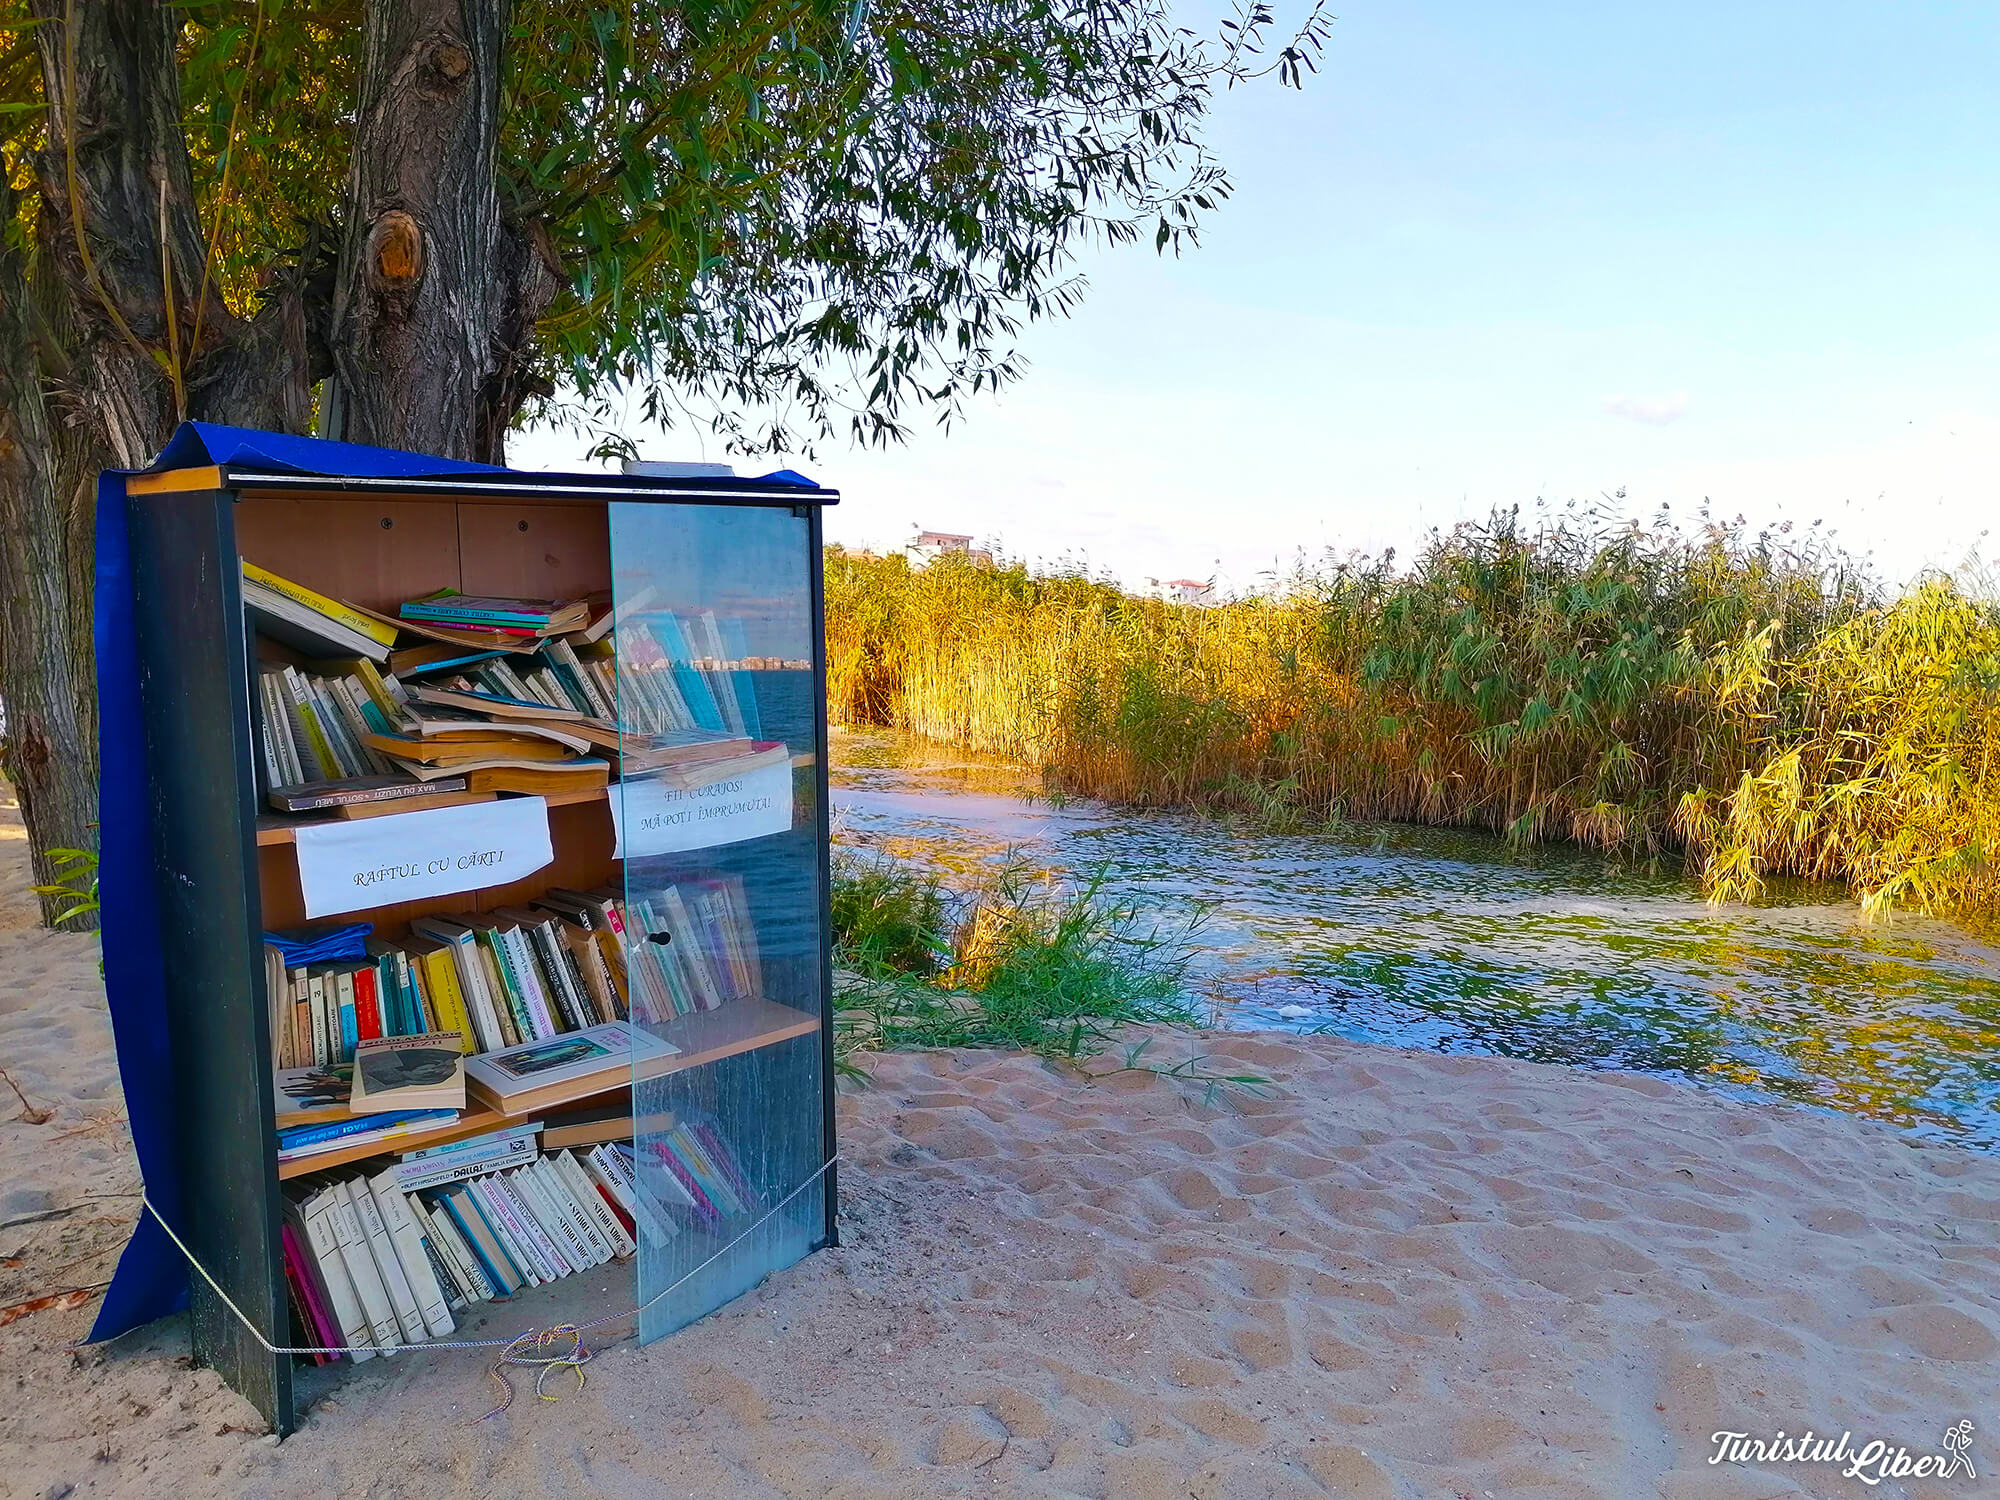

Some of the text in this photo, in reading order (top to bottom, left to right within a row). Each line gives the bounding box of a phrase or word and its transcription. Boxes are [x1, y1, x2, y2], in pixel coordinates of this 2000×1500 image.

[374, 788, 401, 798] VEUZIT
[403, 786, 415, 794] DU
[417, 784, 435, 793] MAX
[689, 780, 744, 799] CURAJOS!
[314, 797, 333, 806] MEU
[641, 813, 661, 831] MĂ
[697, 797, 771, 821] ÎMPRUMUTA!
[353, 850, 504, 887] RAFTUL CU CĂRȚI
[342, 1121, 368, 1134] HAGI
[454, 1164, 483, 1178] DALLAS
[506, 1214, 521, 1234] CHEIA
[355, 1334, 364, 1343] 29
